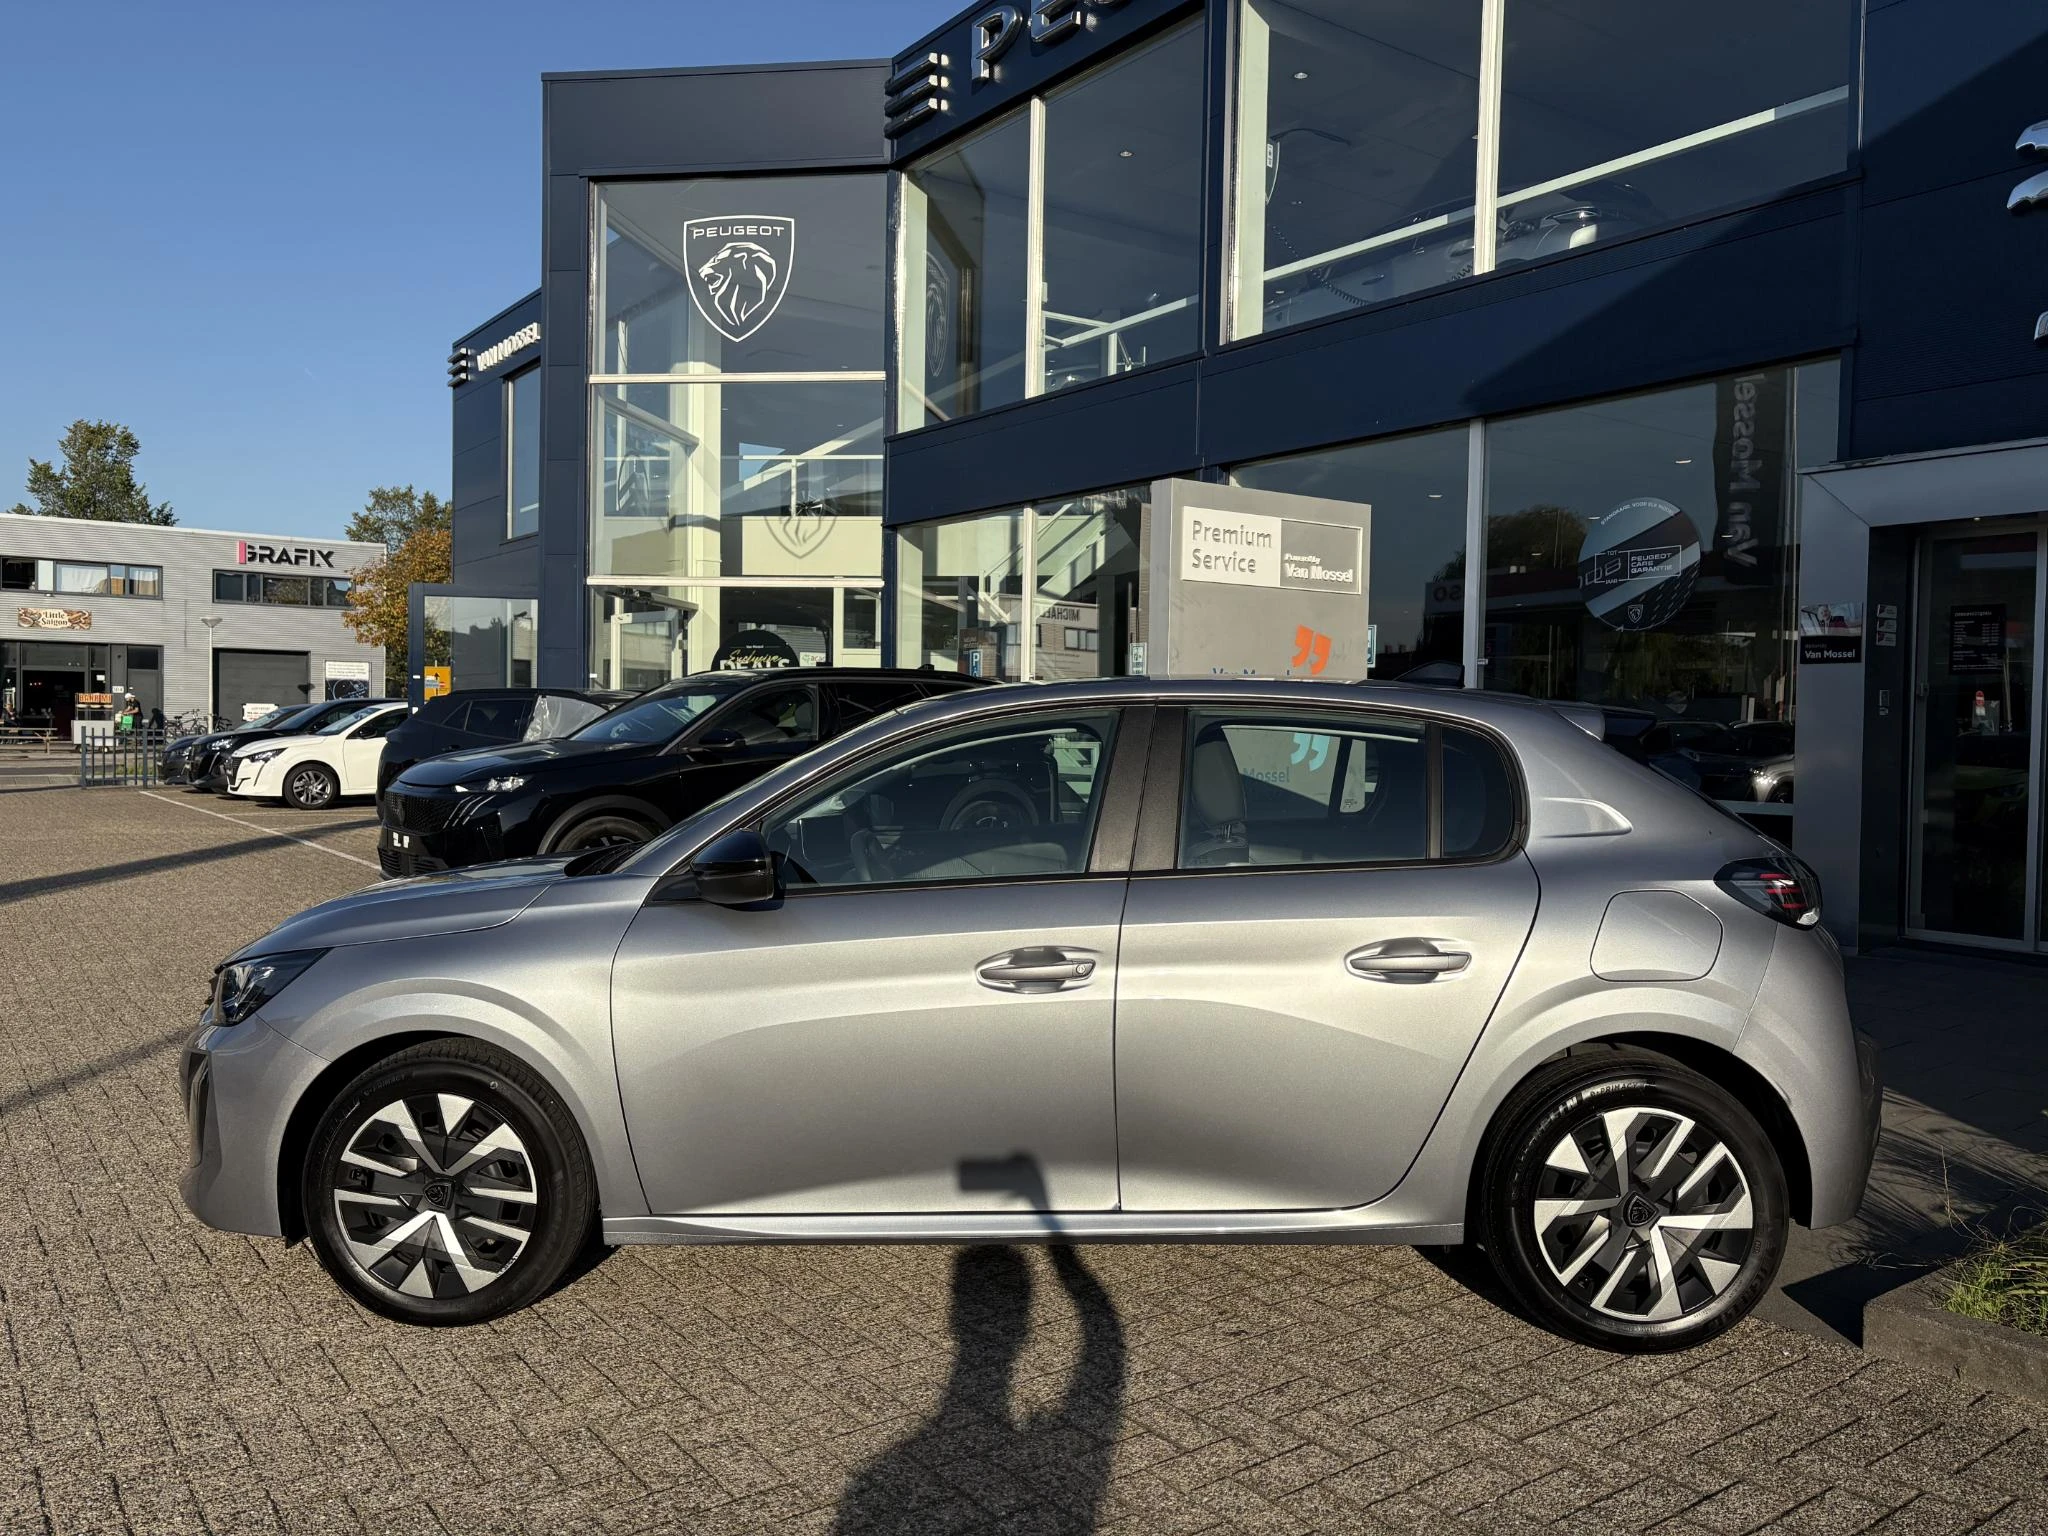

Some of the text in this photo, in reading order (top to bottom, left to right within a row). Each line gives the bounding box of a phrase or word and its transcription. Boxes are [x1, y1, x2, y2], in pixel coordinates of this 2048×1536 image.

[972, 0, 1129, 80] PE
[692, 225, 785, 240] PEUGEOT
[476, 345, 498, 371] VAN
[1191, 520, 1272, 548] Premium
[1191, 548, 1257, 573] Service
[1631, 552, 1673, 562] PEUGEOT
[1284, 563, 1353, 583] Van Mossel
[1631, 565, 1673, 574] GARANTIE
[41, 618, 68, 626] Saigon
[728, 649, 783, 664] Exclusive
[1804, 649, 1856, 659] Van Mossel
